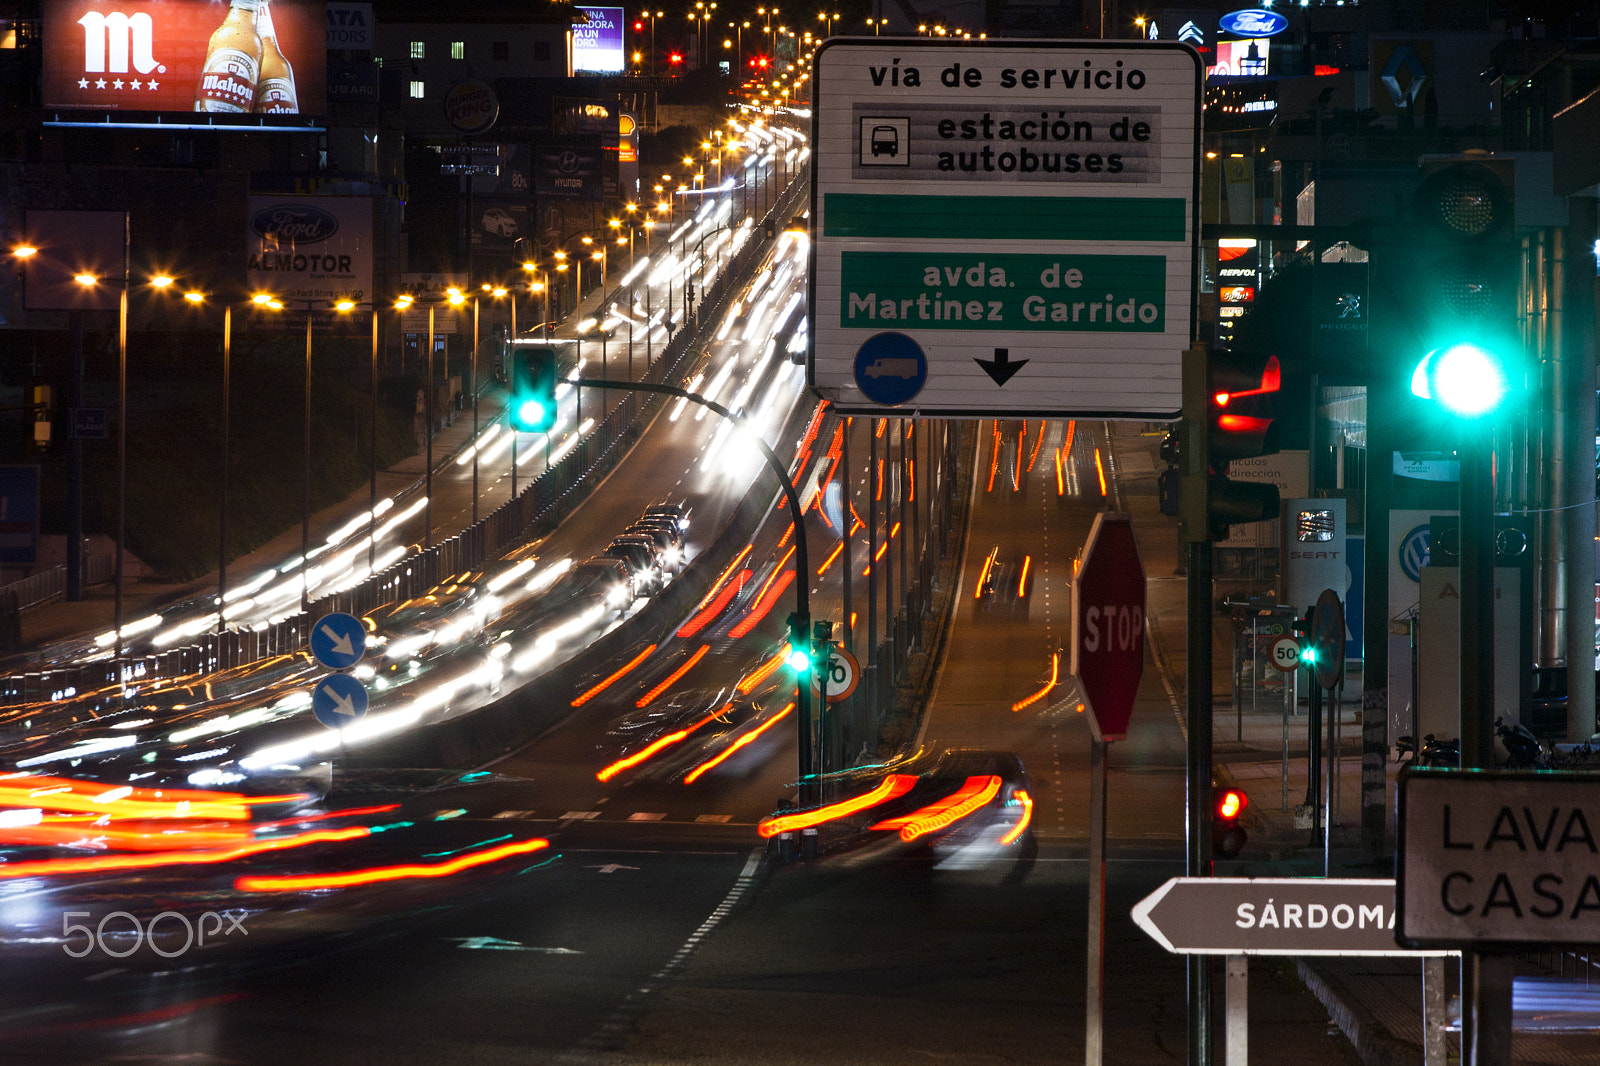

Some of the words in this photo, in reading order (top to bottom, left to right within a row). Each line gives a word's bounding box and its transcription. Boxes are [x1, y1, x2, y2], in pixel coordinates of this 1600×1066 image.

[1232, 13, 1275, 32] Ford
[870, 59, 921, 88] vía
[940, 63, 982, 88] de
[1000, 60, 1147, 90] servicio
[937, 113, 1093, 142] estación
[1109, 117, 1152, 142] de
[937, 147, 1124, 173] autobuses
[554, 178, 583, 188] HYUNDAI
[266, 210, 323, 237] Ford
[923, 261, 1015, 288] avda.
[1040, 263, 1083, 289] de
[1220, 269, 1256, 277] REPSOL
[848, 293, 1003, 322] Martínez
[1022, 294, 1158, 324] Garrido
[1290, 551, 1340, 559] SEAT
[1084, 604, 1143, 653] STOP
[1277, 647, 1296, 660] 50
[1444, 805, 1600, 852] LAVA
[1442, 873, 1600, 919] CASA
